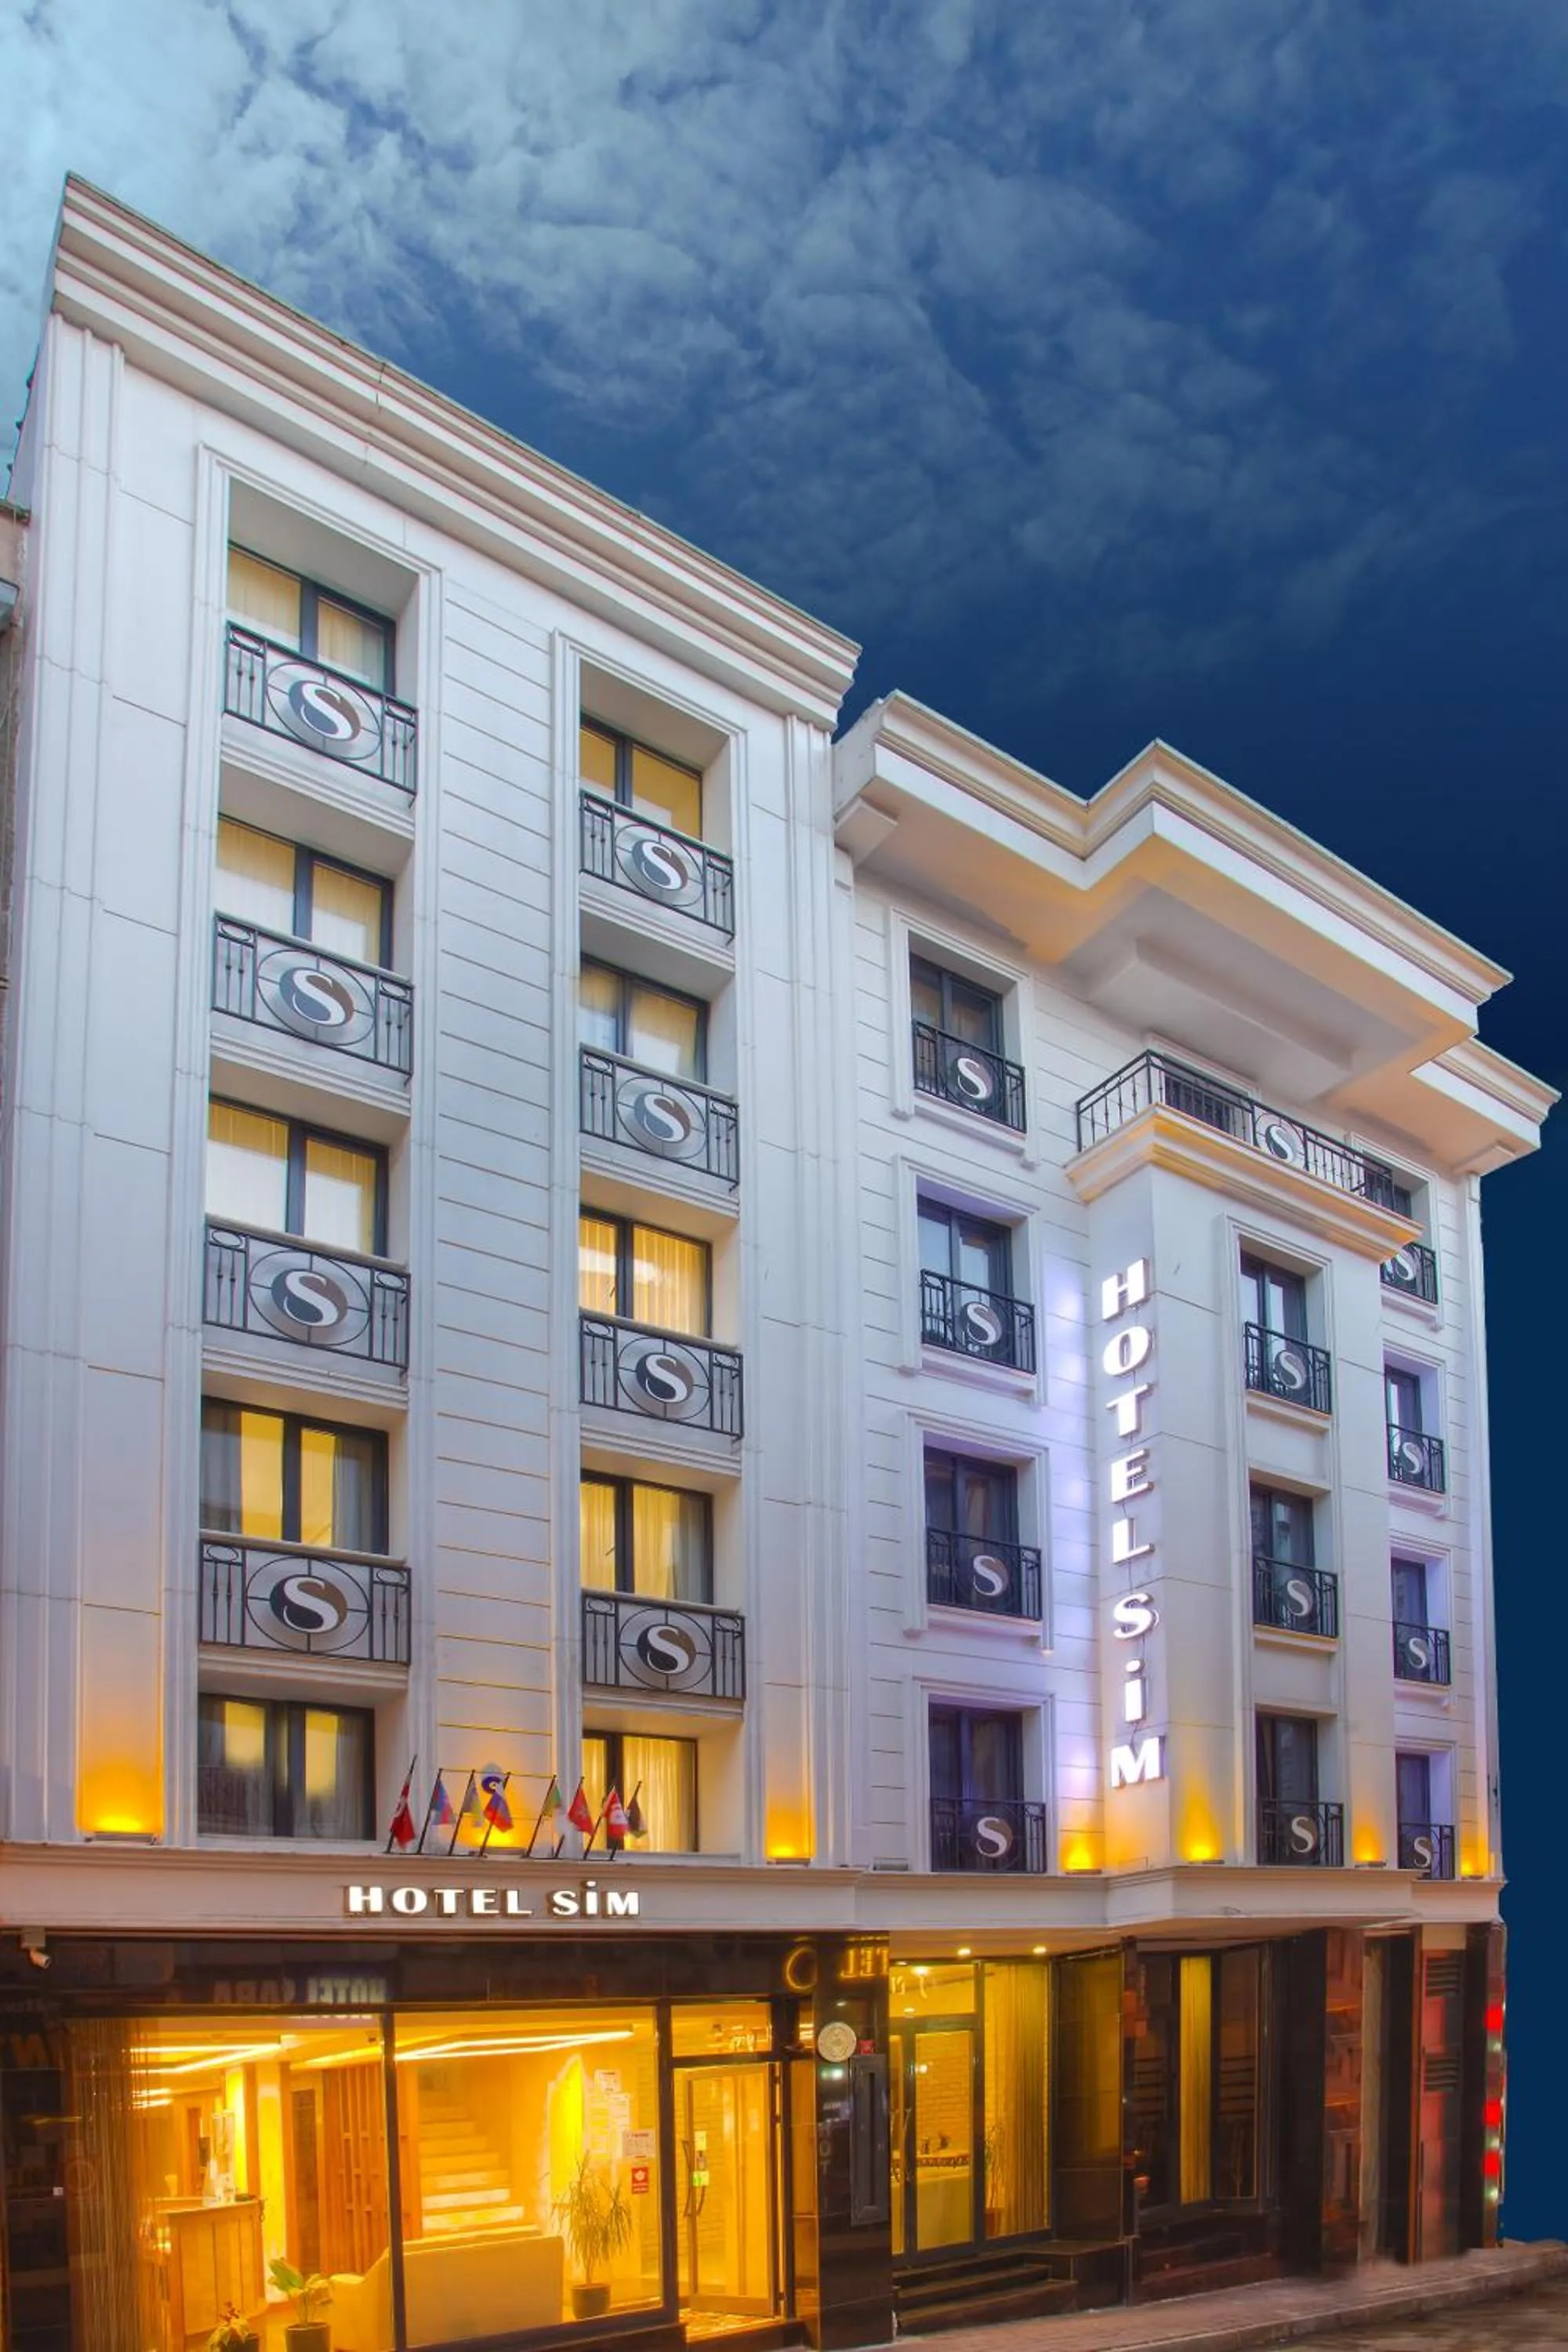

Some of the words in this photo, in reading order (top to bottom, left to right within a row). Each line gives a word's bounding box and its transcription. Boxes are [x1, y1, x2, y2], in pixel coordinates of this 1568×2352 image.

[301, 681, 352, 740] S
[641, 840, 682, 890] S
[292, 968, 345, 1025] S
[957, 1058, 988, 1099] S
[644, 1092, 685, 1143] S
[1269, 1124, 1294, 1163] S
[283, 1270, 339, 1327] S
[967, 1302, 999, 1346] S
[646, 1353, 688, 1403] S
[1279, 1351, 1306, 1389] S
[1102, 1258, 1156, 1565] HOTEL
[1403, 1442, 1423, 1475] S
[973, 1555, 1004, 1596] S
[283, 1575, 339, 1633] S
[1287, 1580, 1312, 1617] S
[647, 1624, 690, 1675] S
[1408, 1636, 1428, 1669] S
[977, 1817, 1007, 1857] S
[1290, 1817, 1315, 1853] S
[1414, 1836, 1432, 1867] S
[346, 1884, 533, 1916] HOTEL
